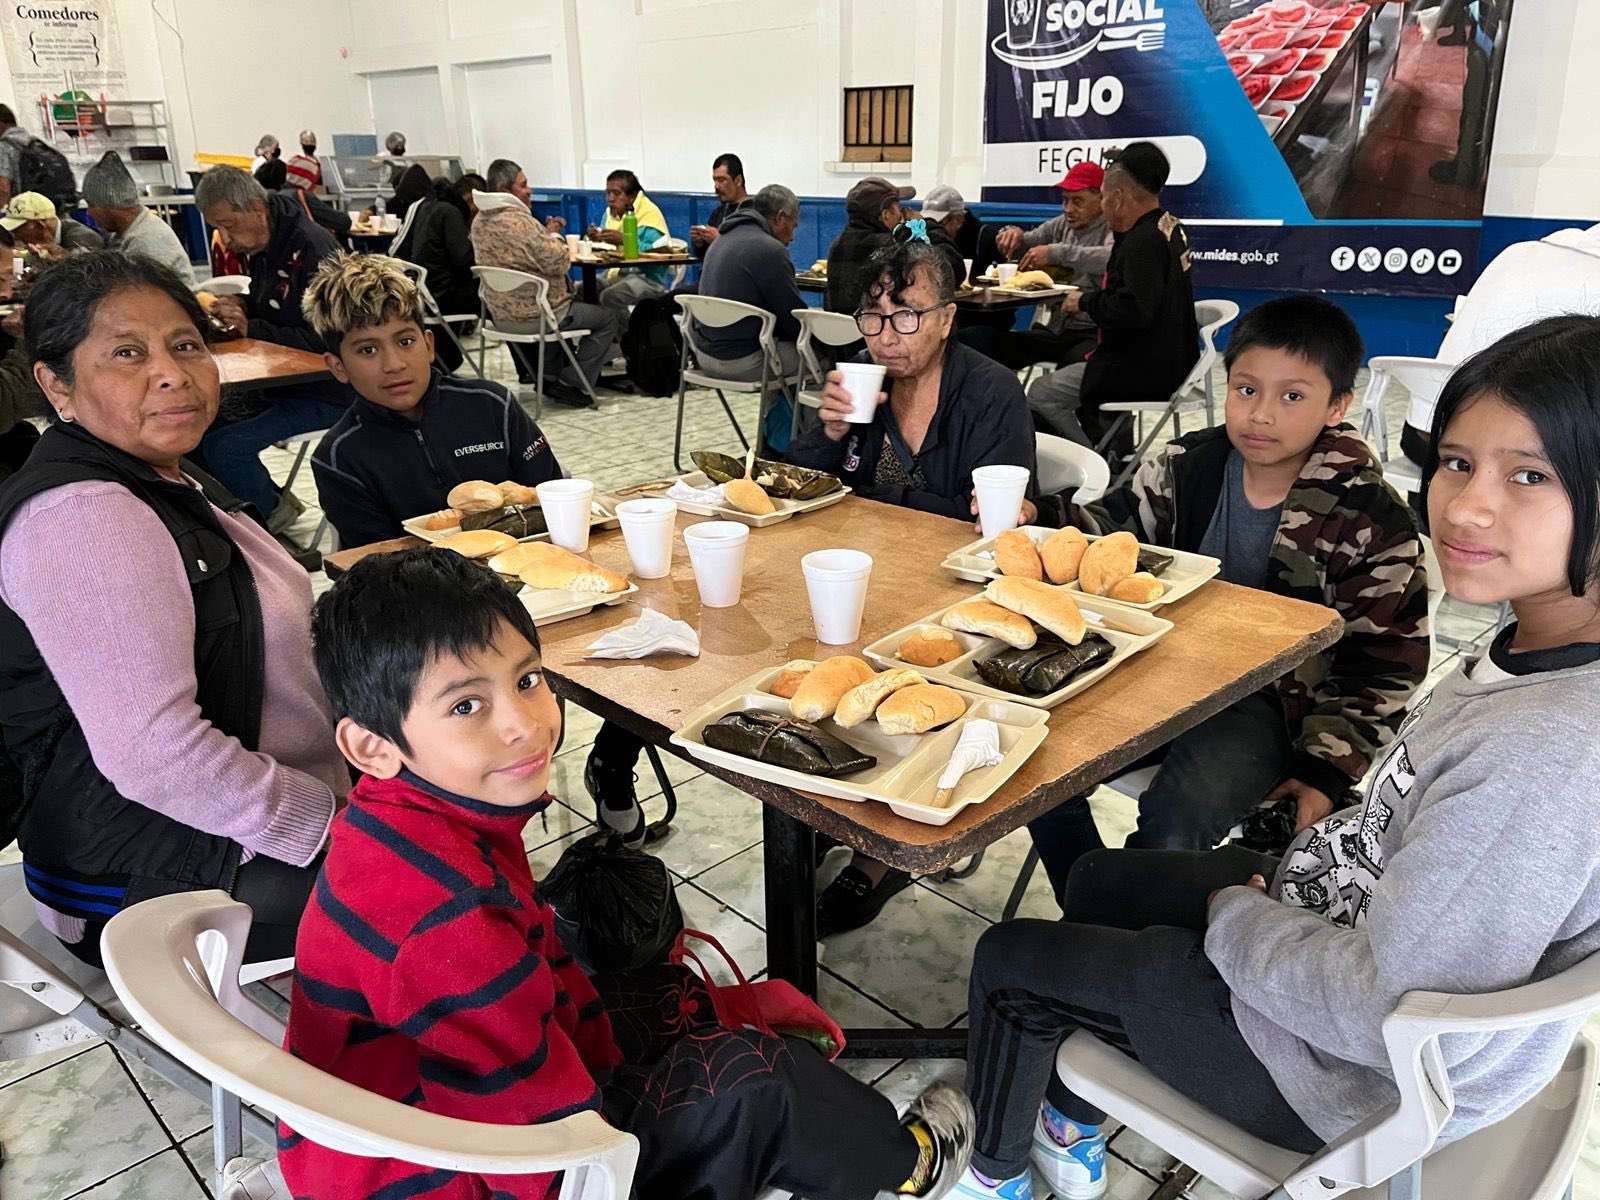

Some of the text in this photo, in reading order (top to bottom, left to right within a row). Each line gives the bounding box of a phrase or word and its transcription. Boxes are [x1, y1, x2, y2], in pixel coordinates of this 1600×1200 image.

[16, 5, 99, 21] Comedores
[1046, 0, 1165, 32] SOCIAL
[1032, 75, 1124, 119] FIJO
[1038, 147, 1113, 173] FEGU
[1189, 249, 1280, 265] w.mides.gob.gt
[454, 441, 504, 457] EVERSOURCE
